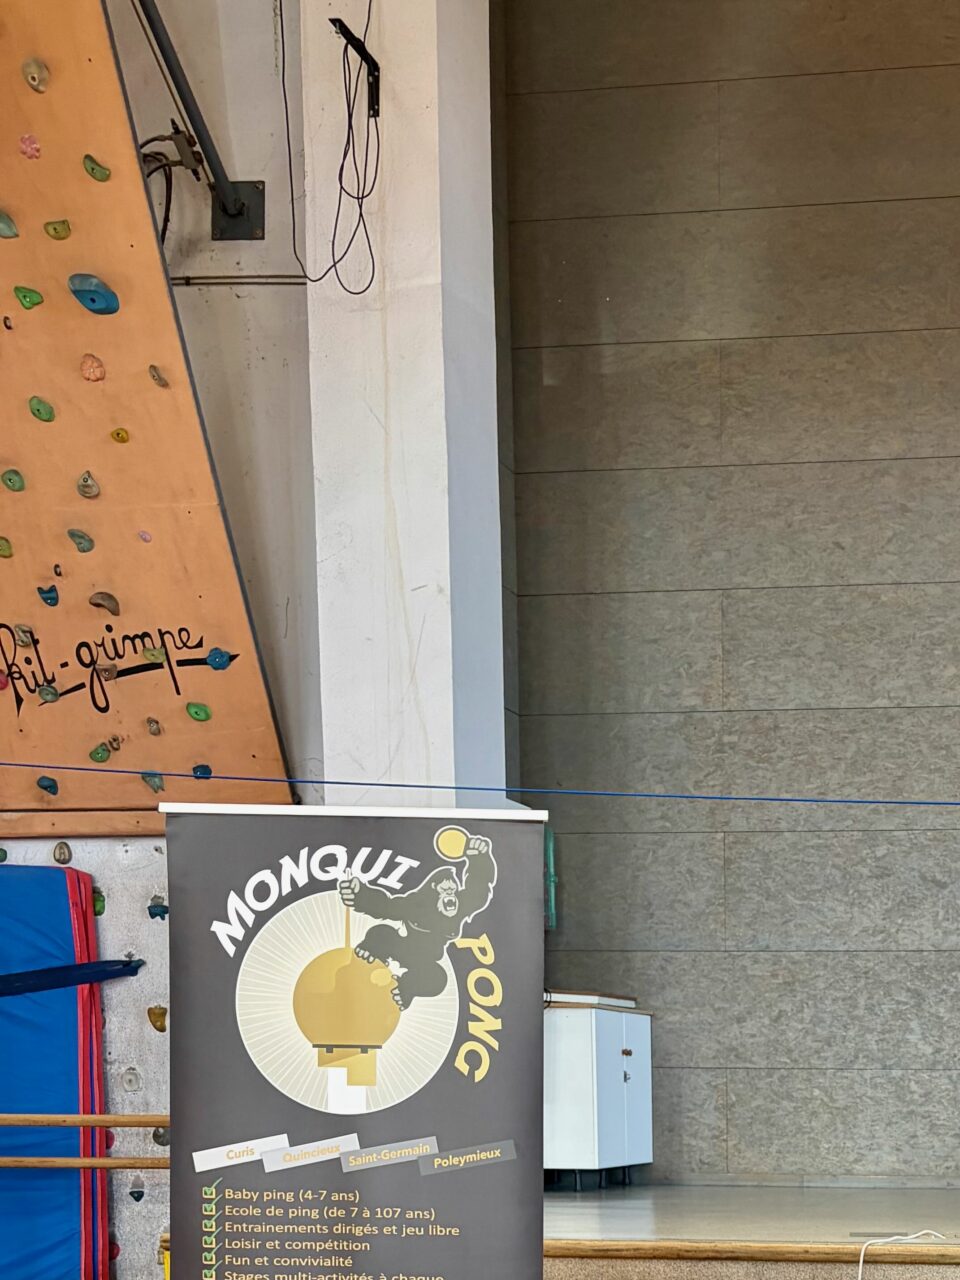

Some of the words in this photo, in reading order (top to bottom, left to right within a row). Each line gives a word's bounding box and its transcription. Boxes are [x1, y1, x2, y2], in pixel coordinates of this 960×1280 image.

[210, 844, 421, 958] MONQUI
[454, 933, 503, 1083] PONG
[226, 1146, 255, 1160] Curis
[282, 1144, 341, 1163] Quincieux
[349, 1143, 430, 1166] Saint-Germain
[433, 1148, 501, 1169] Poleymieux
[225, 1189, 259, 1201] Baby
[264, 1190, 294, 1202] ping
[299, 1190, 327, 1202] (4-7
[331, 1190, 360, 1203] ans)
[225, 1205, 262, 1216] Ecole
[266, 1206, 284, 1217] de
[289, 1207, 319, 1219] ping
[323, 1207, 346, 1219] (de
[351, 1208, 358, 1218] 7
[363, 1207, 371, 1218] à
[375, 1208, 401, 1218] 107
[405, 1208, 435, 1220] ans)
[225, 1222, 328, 1234] Entrainements
[333, 1224, 379, 1237] dirigés
[383, 1225, 398, 1235] et
[401, 1224, 424, 1237] jeu
[429, 1225, 460, 1236] libre
[225, 1239, 262, 1249] Loisir
[266, 1240, 280, 1249] et
[285, 1239, 370, 1252] compétition
[225, 1255, 250, 1265] Fun
[255, 1256, 269, 1266] et
[273, 1255, 353, 1267] convivialité
